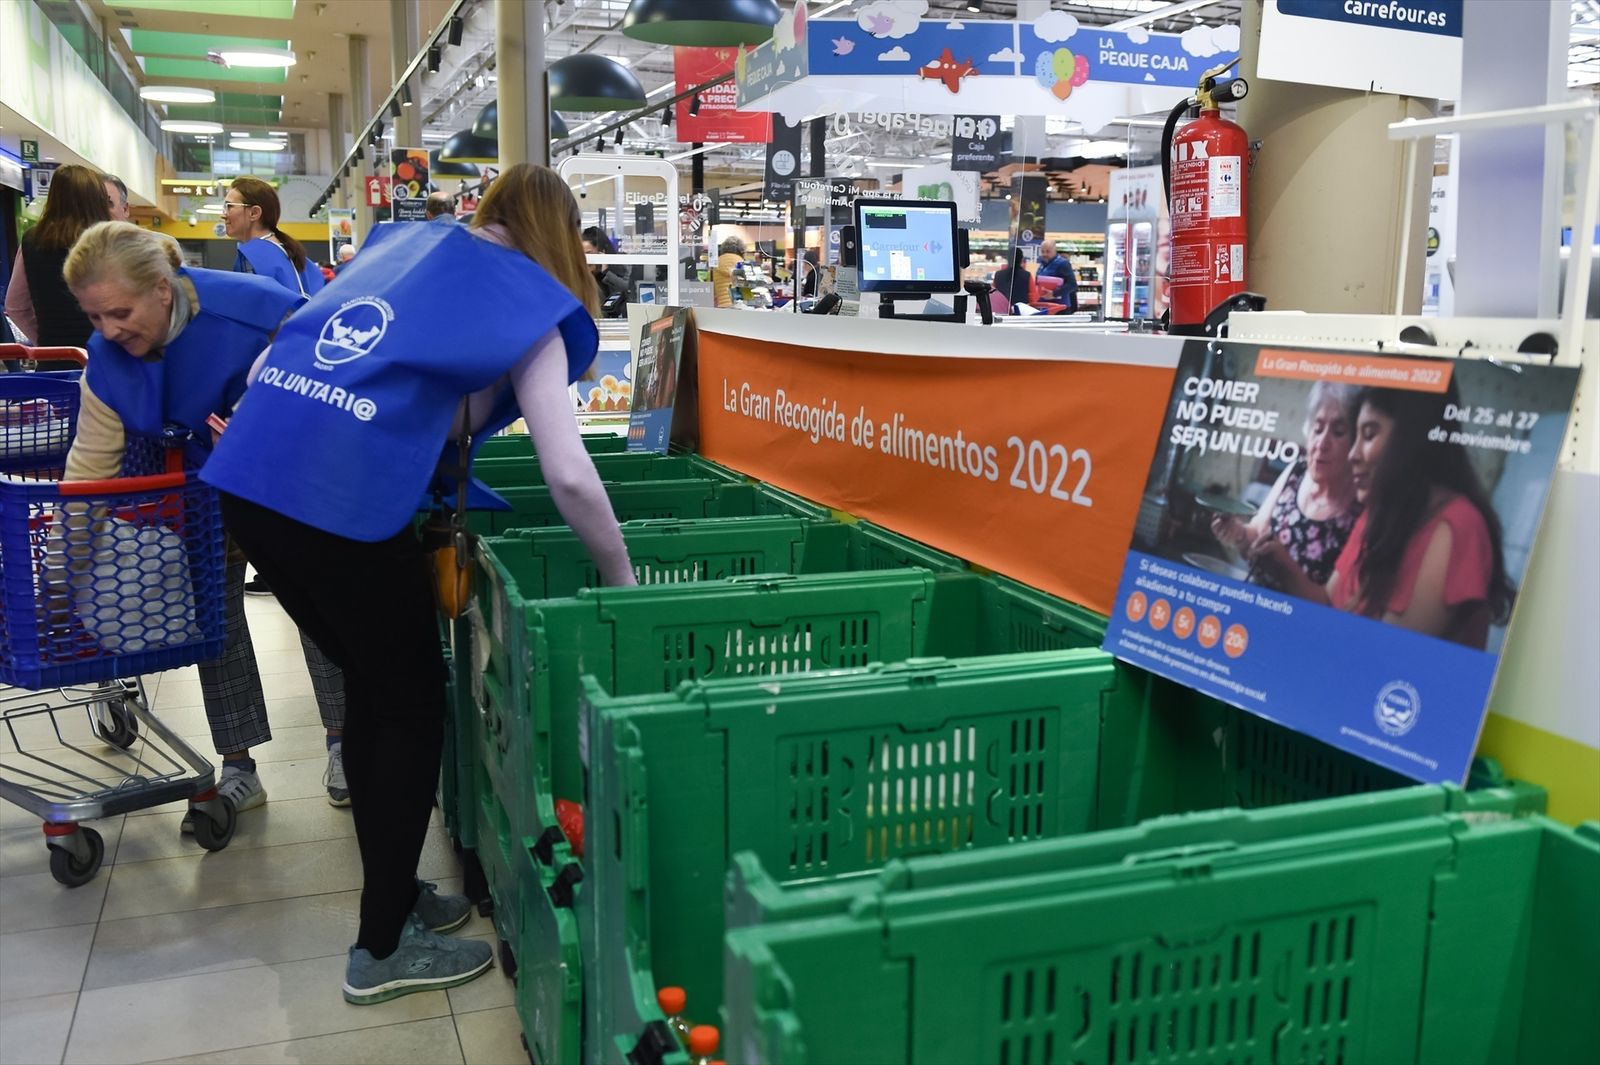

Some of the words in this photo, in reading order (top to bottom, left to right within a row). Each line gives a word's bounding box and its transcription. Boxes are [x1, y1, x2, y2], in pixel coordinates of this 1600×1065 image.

[1344, 0, 1447, 27] carrefour.es
[1099, 37, 1114, 49] LA
[1099, 50, 1149, 68] PEQUE
[1150, 54, 1189, 71] CAJA
[688, 84, 737, 94] NVIDAD
[707, 94, 737, 104] PRECI
[957, 153, 995, 162] preferente
[968, 142, 985, 152] Caja
[625, 191, 690, 206] EligePel
[872, 241, 919, 251] Carrefour
[1263, 357, 1273, 369] La
[1275, 358, 1298, 370] Gran
[1299, 359, 1342, 377] Recogida
[1343, 363, 1357, 376] de
[1359, 365, 1408, 380] alimentos
[1410, 368, 1442, 384] 2022
[1184, 377, 1260, 403] COMER
[1176, 400, 1208, 422] NO
[1210, 404, 1280, 432] PUEDE
[1443, 403, 1471, 423] Del
[1472, 406, 1495, 425] 25
[1496, 410, 1514, 427] al
[1515, 411, 1539, 430] 27
[723, 378, 737, 413] La
[740, 382, 771, 422] Gran
[774, 389, 846, 444] Recogida
[851, 405, 874, 450] de
[880, 412, 1000, 481] alimentos
[1007, 435, 1094, 507] 2022
[1170, 425, 1209, 448] SER
[1210, 429, 1242, 453] UN
[1428, 425, 1448, 442] de
[1449, 430, 1532, 454] noviembre
[1135, 576, 1178, 598] añadiendo
[1178, 590, 1185, 600] a
[1185, 592, 1196, 603] tu
[1196, 596, 1231, 615] compra
[1139, 559, 1149, 570] Si
[1149, 562, 1178, 581] deseas
[1178, 572, 1220, 592] colaborar
[1219, 585, 1254, 604] puedes
[1255, 593, 1293, 615] hacerlo
